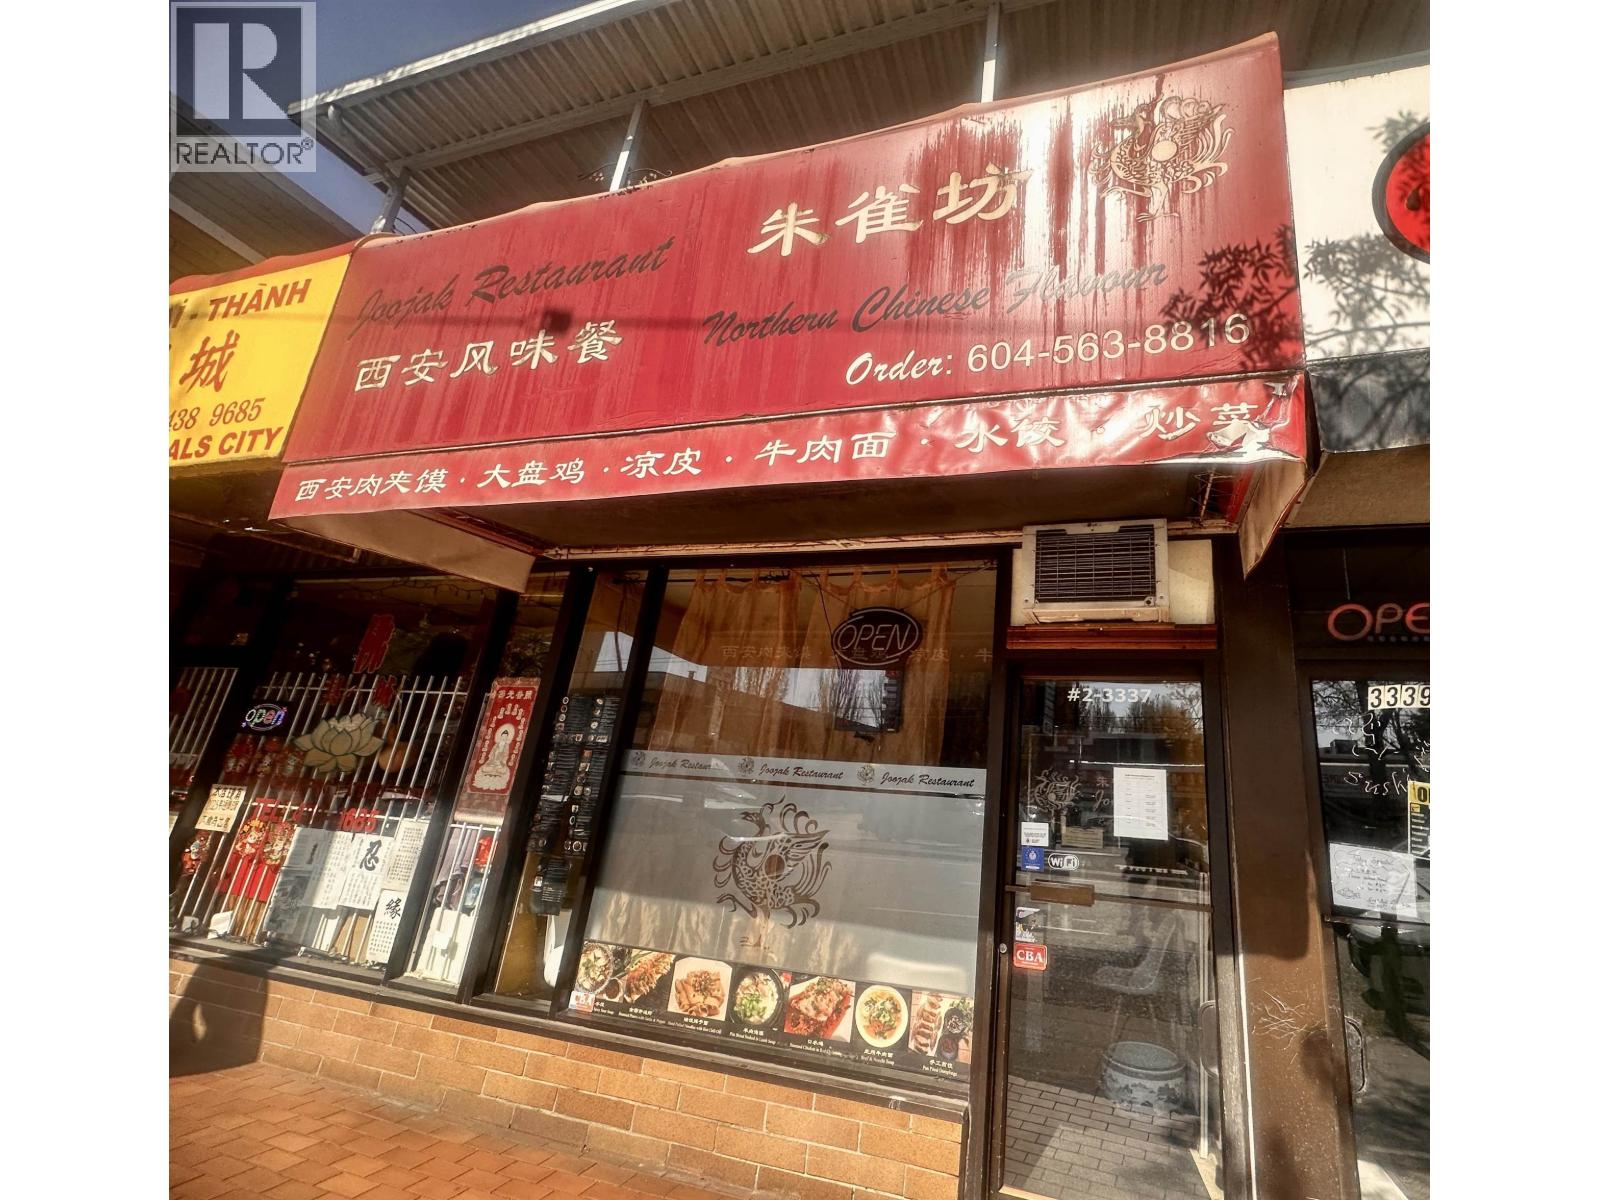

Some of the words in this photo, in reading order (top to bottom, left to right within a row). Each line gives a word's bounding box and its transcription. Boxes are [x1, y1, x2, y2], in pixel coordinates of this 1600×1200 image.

[747, 164, 1032, 256] 朱雀坊
[348, 274, 456, 341] Joojak
[467, 237, 676, 307] Restaurant
[702, 303, 838, 347] Northern
[852, 286, 990, 333] Chinese
[1006, 262, 1168, 313] Flavour
[354, 320, 623, 392] 西安风味餐
[845, 351, 954, 385] Order:
[965, 313, 1250, 372] 604-563-8816
[209, 397, 266, 427] 9685
[218, 427, 284, 455] CITY
[295, 468, 447, 502] 西安肉夹馍
[477, 457, 585, 489] 大盘鸡
[620, 448, 702, 477] 凉皮
[754, 431, 898, 466] 牛肉面
[836, 622, 911, 652] OPEN
[1067, 688, 1151, 703] #2-3337
[246, 708, 286, 728] open
[759, 763, 790, 777] Joojak
[793, 766, 845, 780] Restaurant
[880, 772, 915, 786] Joojak
[919, 774, 975, 788] Restaurant
[1016, 949, 1044, 963] CBA
